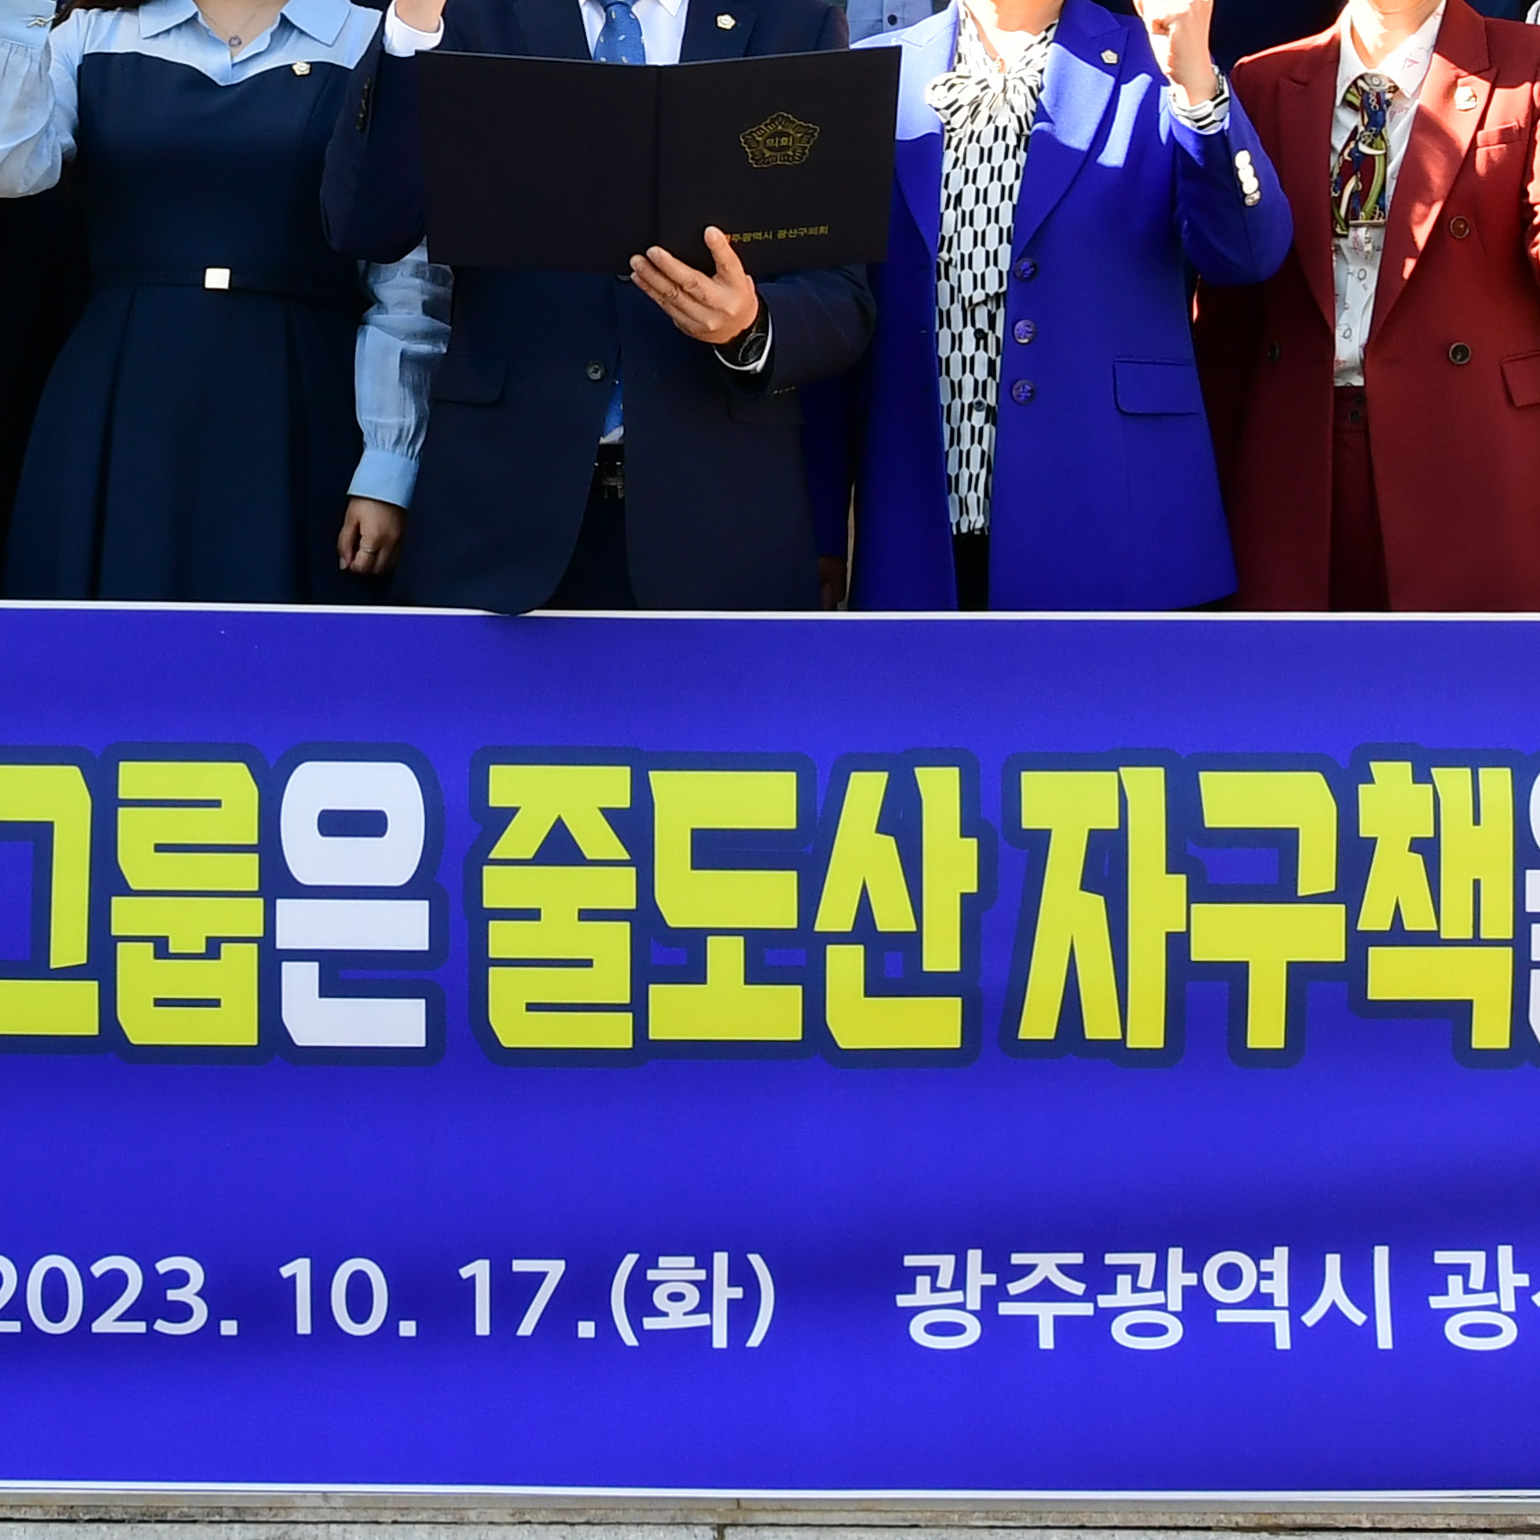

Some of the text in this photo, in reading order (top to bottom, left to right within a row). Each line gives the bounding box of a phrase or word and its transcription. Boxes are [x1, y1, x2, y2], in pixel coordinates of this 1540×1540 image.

[765, 135, 793, 148] 의회
[777, 224, 829, 240] 광산구의회
[483, 765, 978, 1049] 줄도산
[279, 1258, 416, 1337] 10.
[458, 1251, 775, 1349] 17.(화)
[895, 1246, 1393, 1350] 광주광역시
